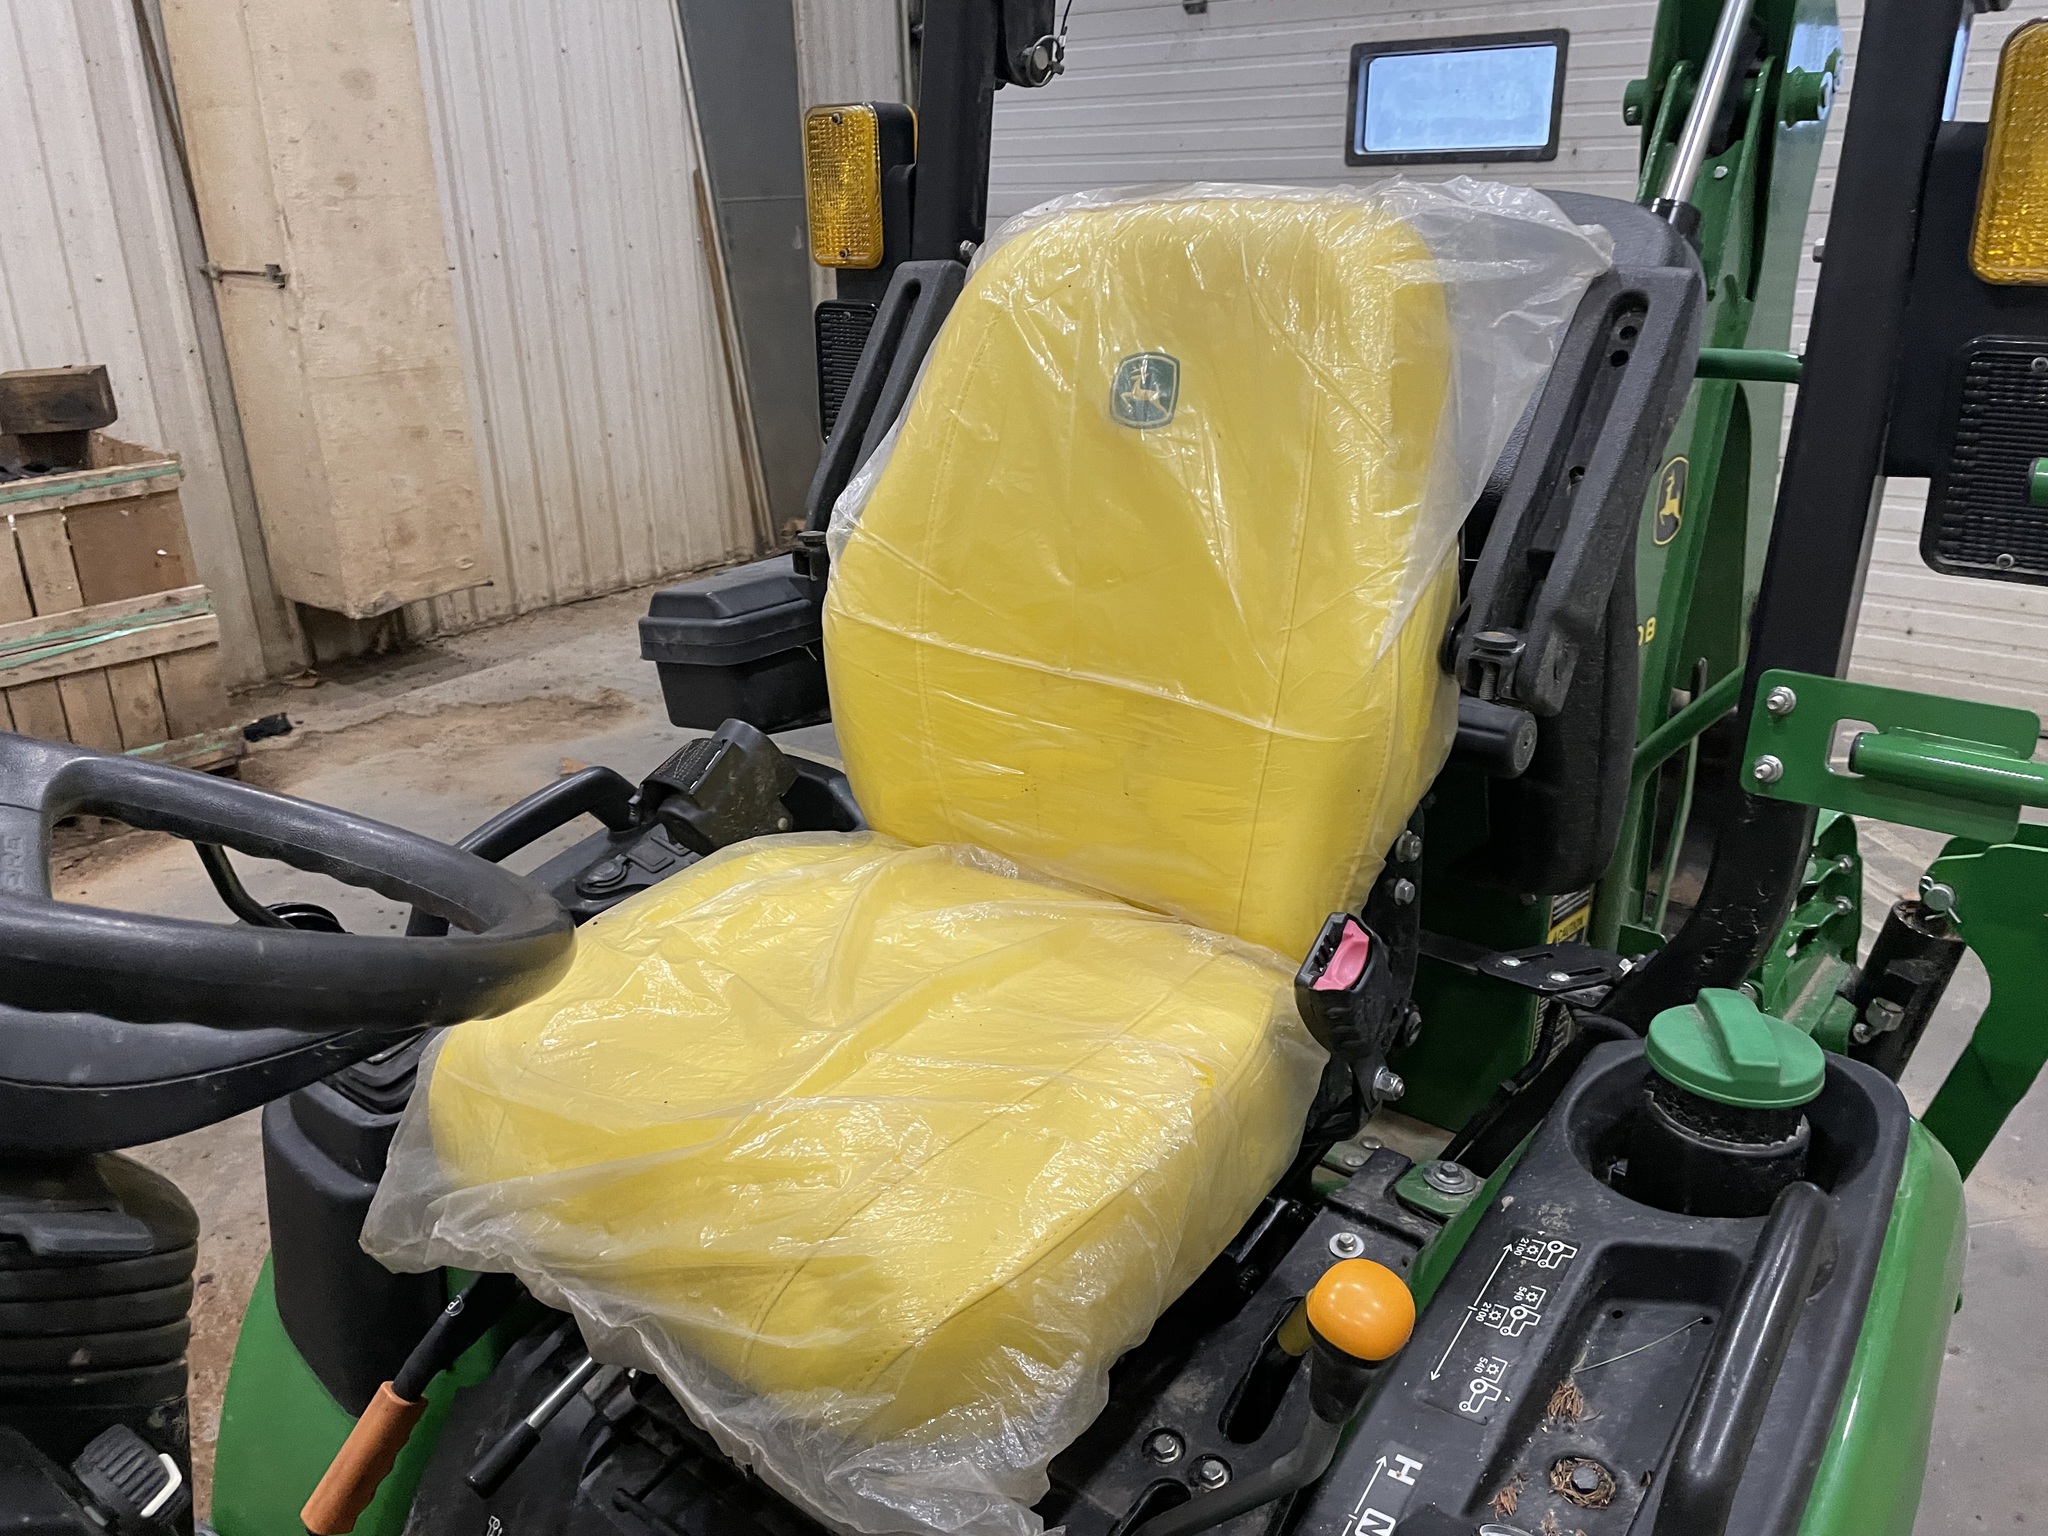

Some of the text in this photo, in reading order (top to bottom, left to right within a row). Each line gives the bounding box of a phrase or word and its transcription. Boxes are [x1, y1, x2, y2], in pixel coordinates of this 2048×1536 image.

[1514, 1238, 1529, 1255] 2100
[1513, 1286, 1527, 1301] 540
[1475, 1302, 1492, 1322] 2100
[1474, 1357, 1488, 1373] 540
[1387, 1454, 1423, 1486] H
